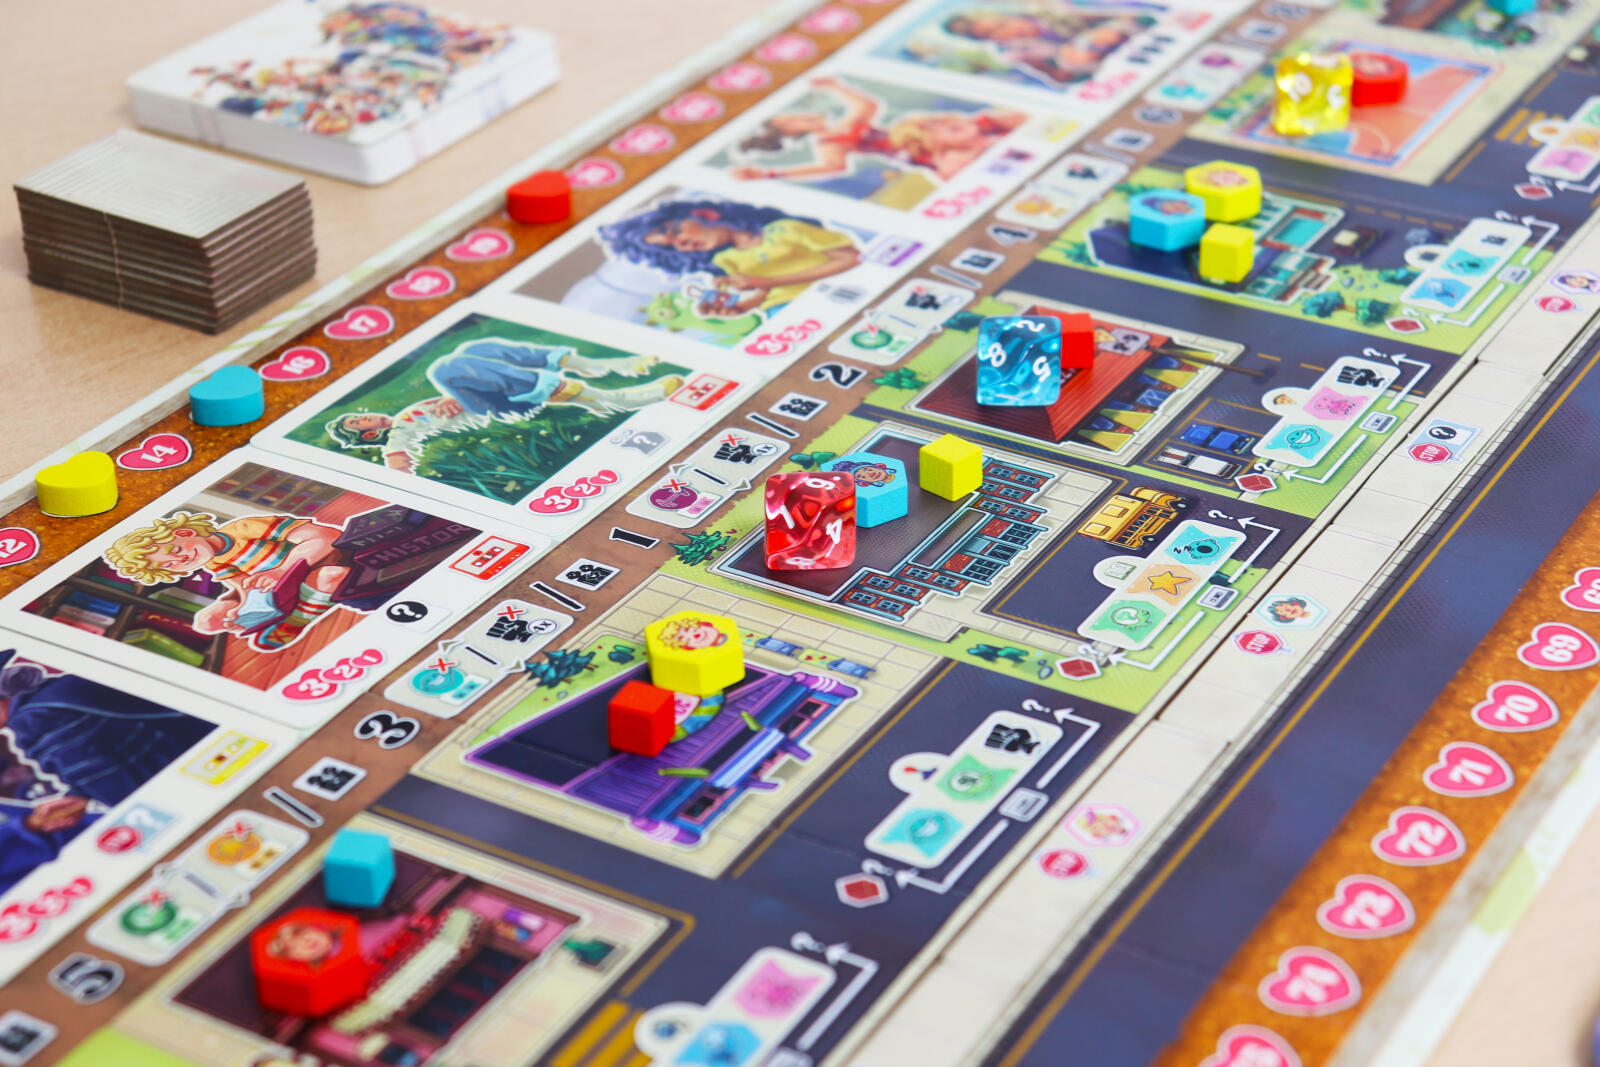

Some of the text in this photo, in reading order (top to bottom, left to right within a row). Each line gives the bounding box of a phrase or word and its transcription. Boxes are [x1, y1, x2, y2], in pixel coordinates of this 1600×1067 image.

[348, 314, 378, 333] 17
[1016, 320, 1045, 332] 2
[283, 355, 315, 374] 16
[988, 342, 1007, 367] 8
[812, 364, 863, 388] 2
[141, 445, 178, 463] 14
[1419, 445, 1440, 460] STOP
[544, 494, 572, 510] 3
[575, 484, 596, 495] 2
[611, 528, 657, 548] 1
[826, 518, 842, 544] 4
[1246, 632, 1270, 651] STOP
[1541, 634, 1582, 663] 69
[298, 678, 329, 697] 3
[333, 665, 354, 678] 2
[1494, 694, 1539, 724] 70
[359, 713, 415, 745] 3
[1449, 758, 1493, 785] 71
[1397, 819, 1447, 856] 72
[1342, 889, 1394, 928] 73
[58, 959, 115, 995] 5
